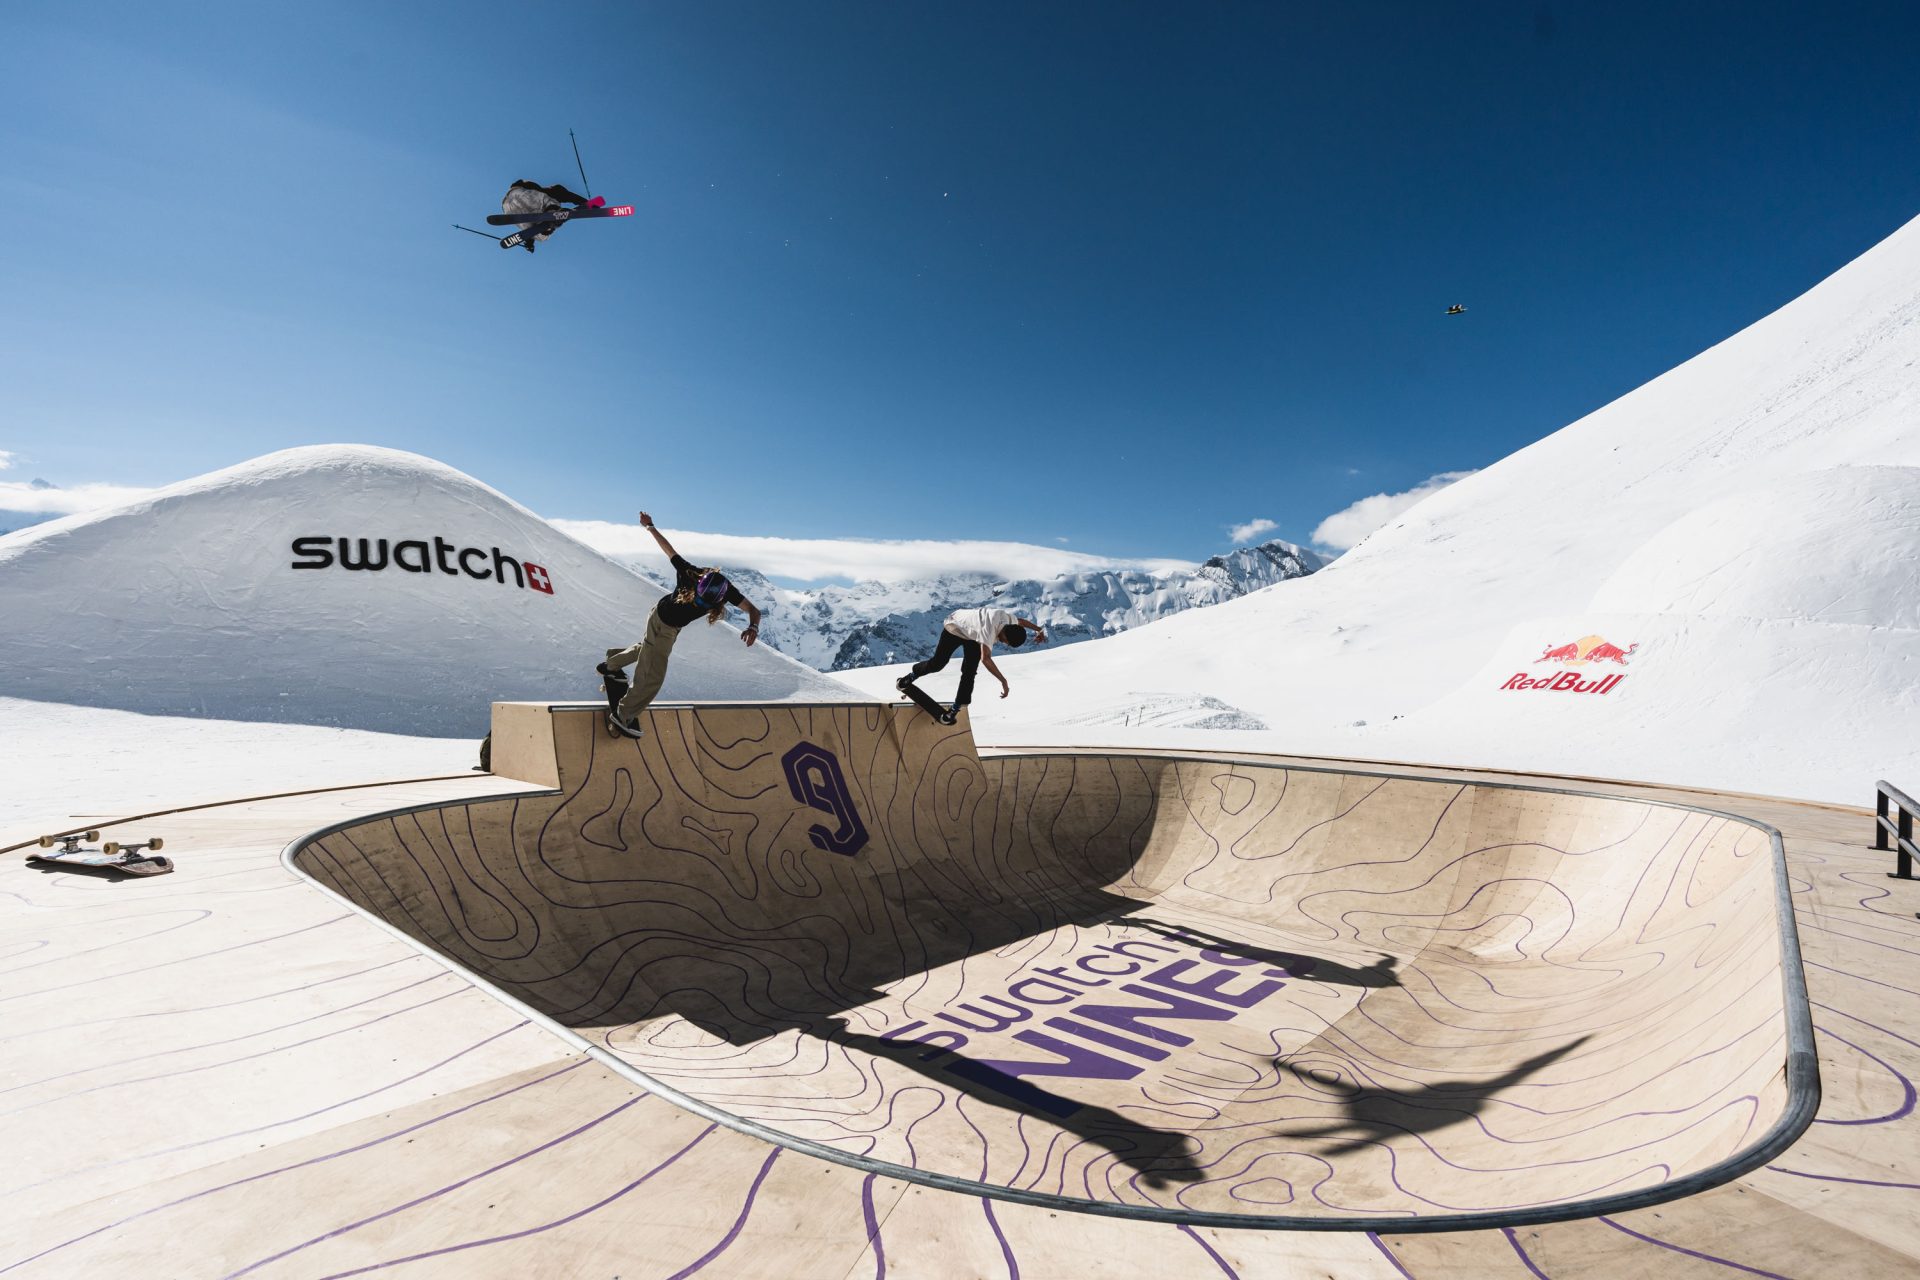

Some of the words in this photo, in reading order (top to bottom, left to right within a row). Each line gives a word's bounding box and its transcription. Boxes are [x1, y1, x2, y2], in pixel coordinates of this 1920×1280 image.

[503, 233, 523, 247] LINE
[613, 206, 632, 216] LINE
[291, 536, 525, 588] swatch
[781, 741, 869, 857] 9
[879, 940, 1179, 1061] swatch
[943, 942, 1316, 1118] NINES
